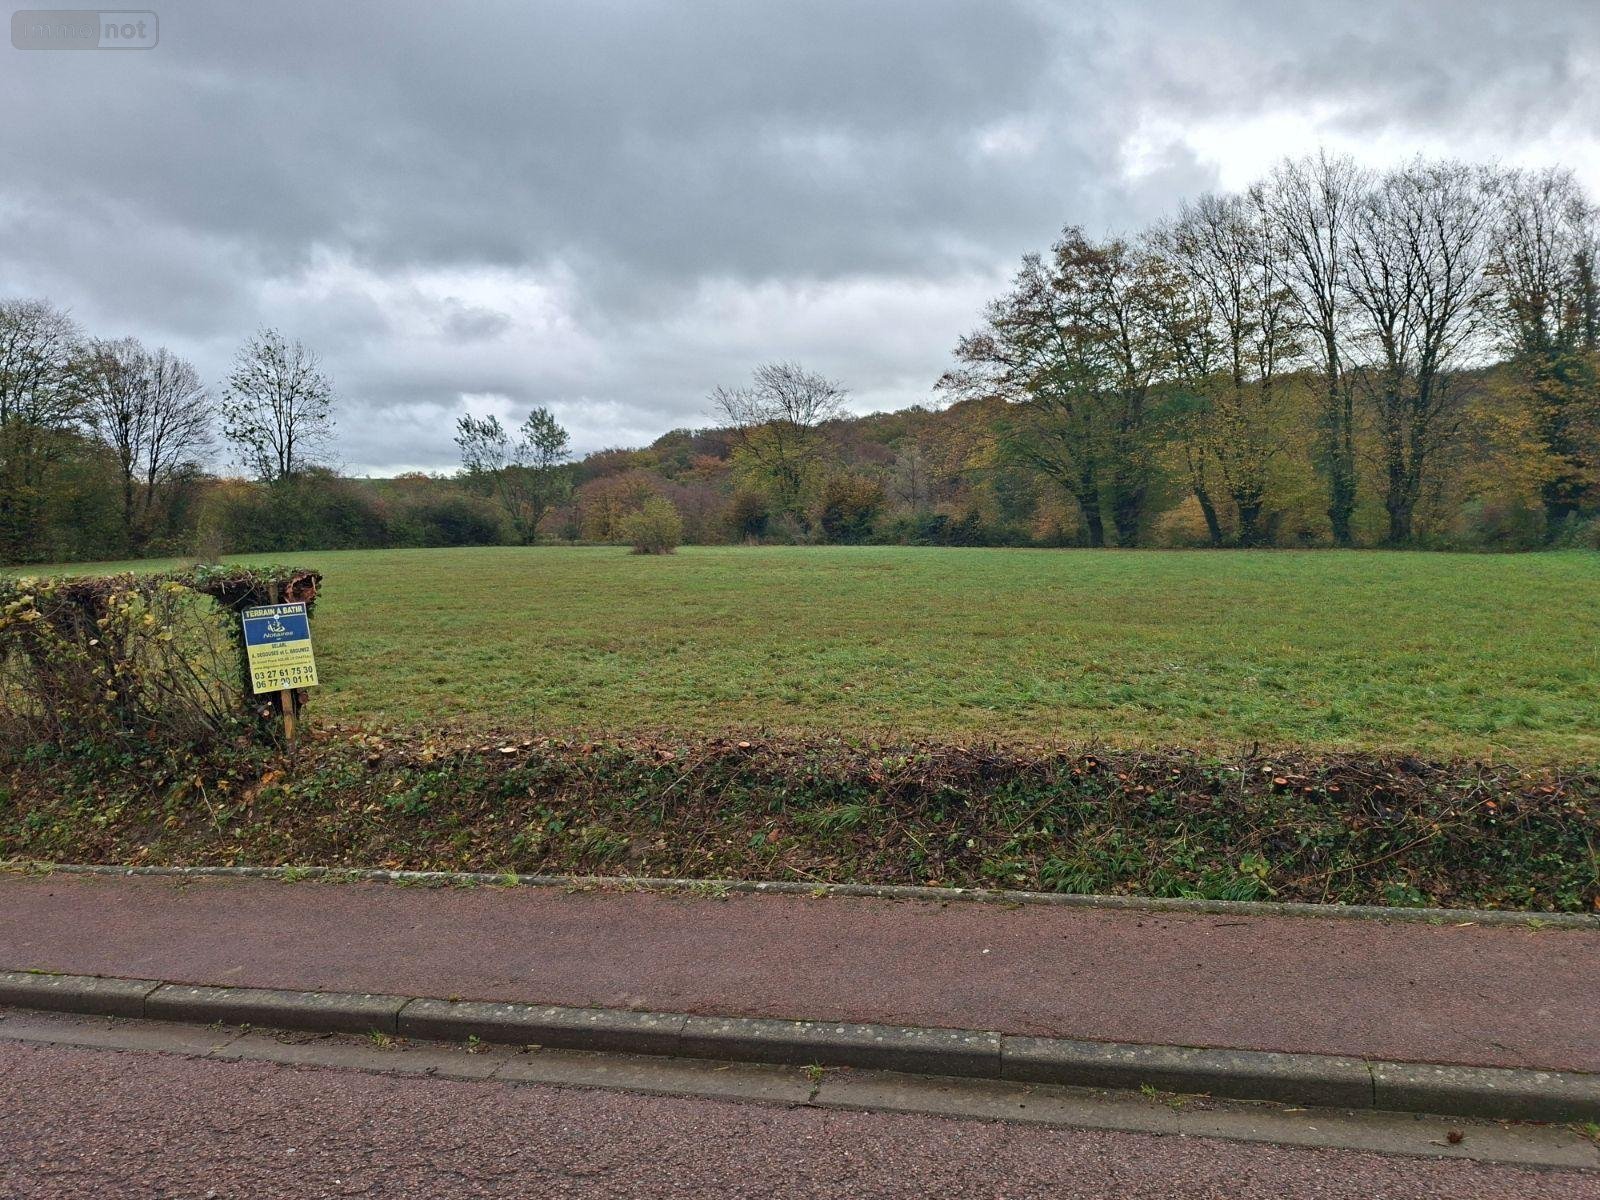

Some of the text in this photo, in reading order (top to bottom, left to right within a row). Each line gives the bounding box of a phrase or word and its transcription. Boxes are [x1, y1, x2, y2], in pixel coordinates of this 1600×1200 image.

[245, 609, 275, 618] TERRAIN
[282, 605, 303, 614] BATIR
[263, 631, 294, 639] Notaires
[254, 671, 265, 680] 03
[267, 669, 277, 678] 27
[279, 668, 289, 677] 61
[291, 667, 302, 675] 75
[303, 665, 313, 673] 30
[256, 680, 267, 689] 06
[269, 679, 278, 687] 77
[292, 676, 302, 684] 01
[305, 674, 314, 682] 11
